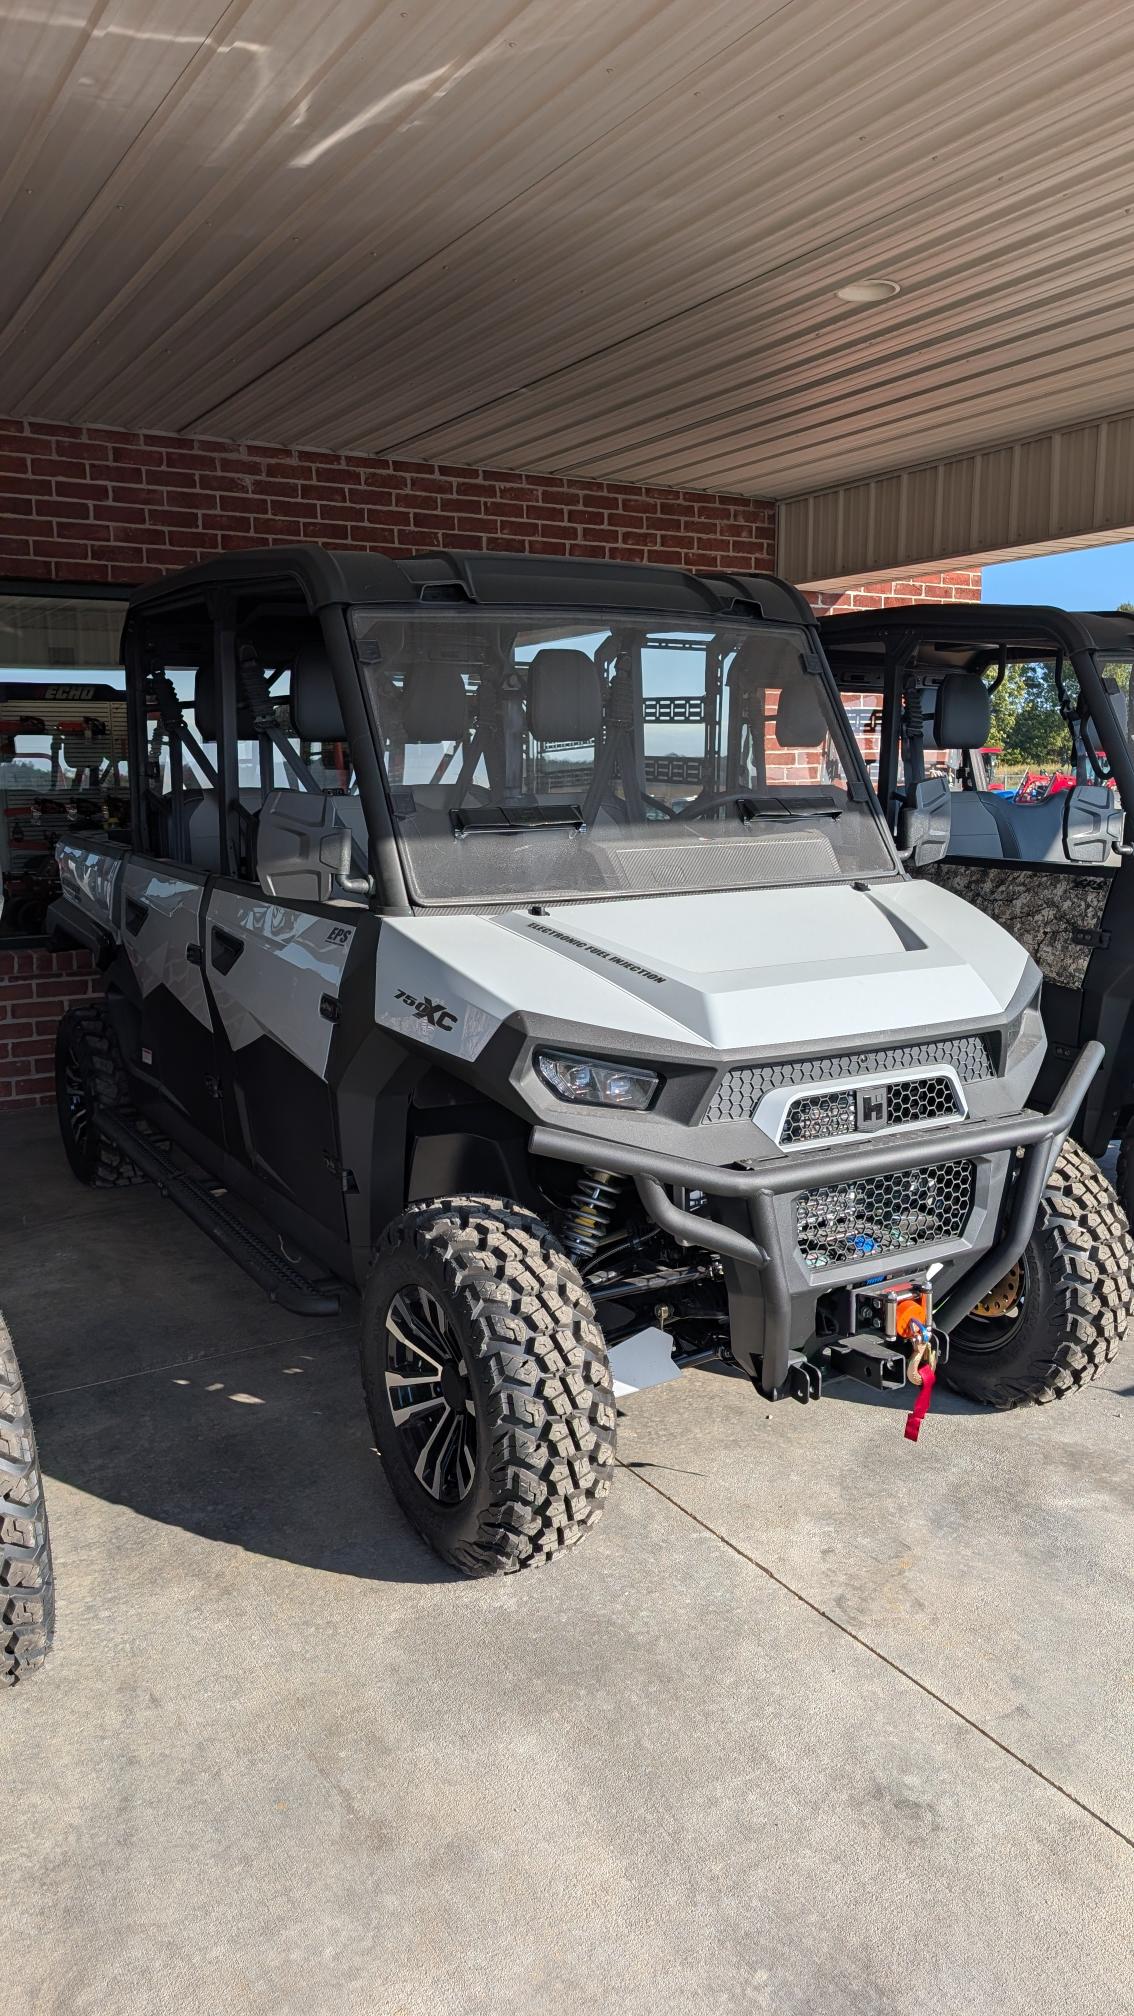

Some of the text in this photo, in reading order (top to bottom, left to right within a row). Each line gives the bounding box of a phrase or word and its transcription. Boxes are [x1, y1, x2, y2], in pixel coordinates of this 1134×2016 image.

[45, 686, 96, 700] ECHO
[327, 927, 352, 943] EPS
[527, 922, 667, 984] ELECTRONIC FUEL INJECTION
